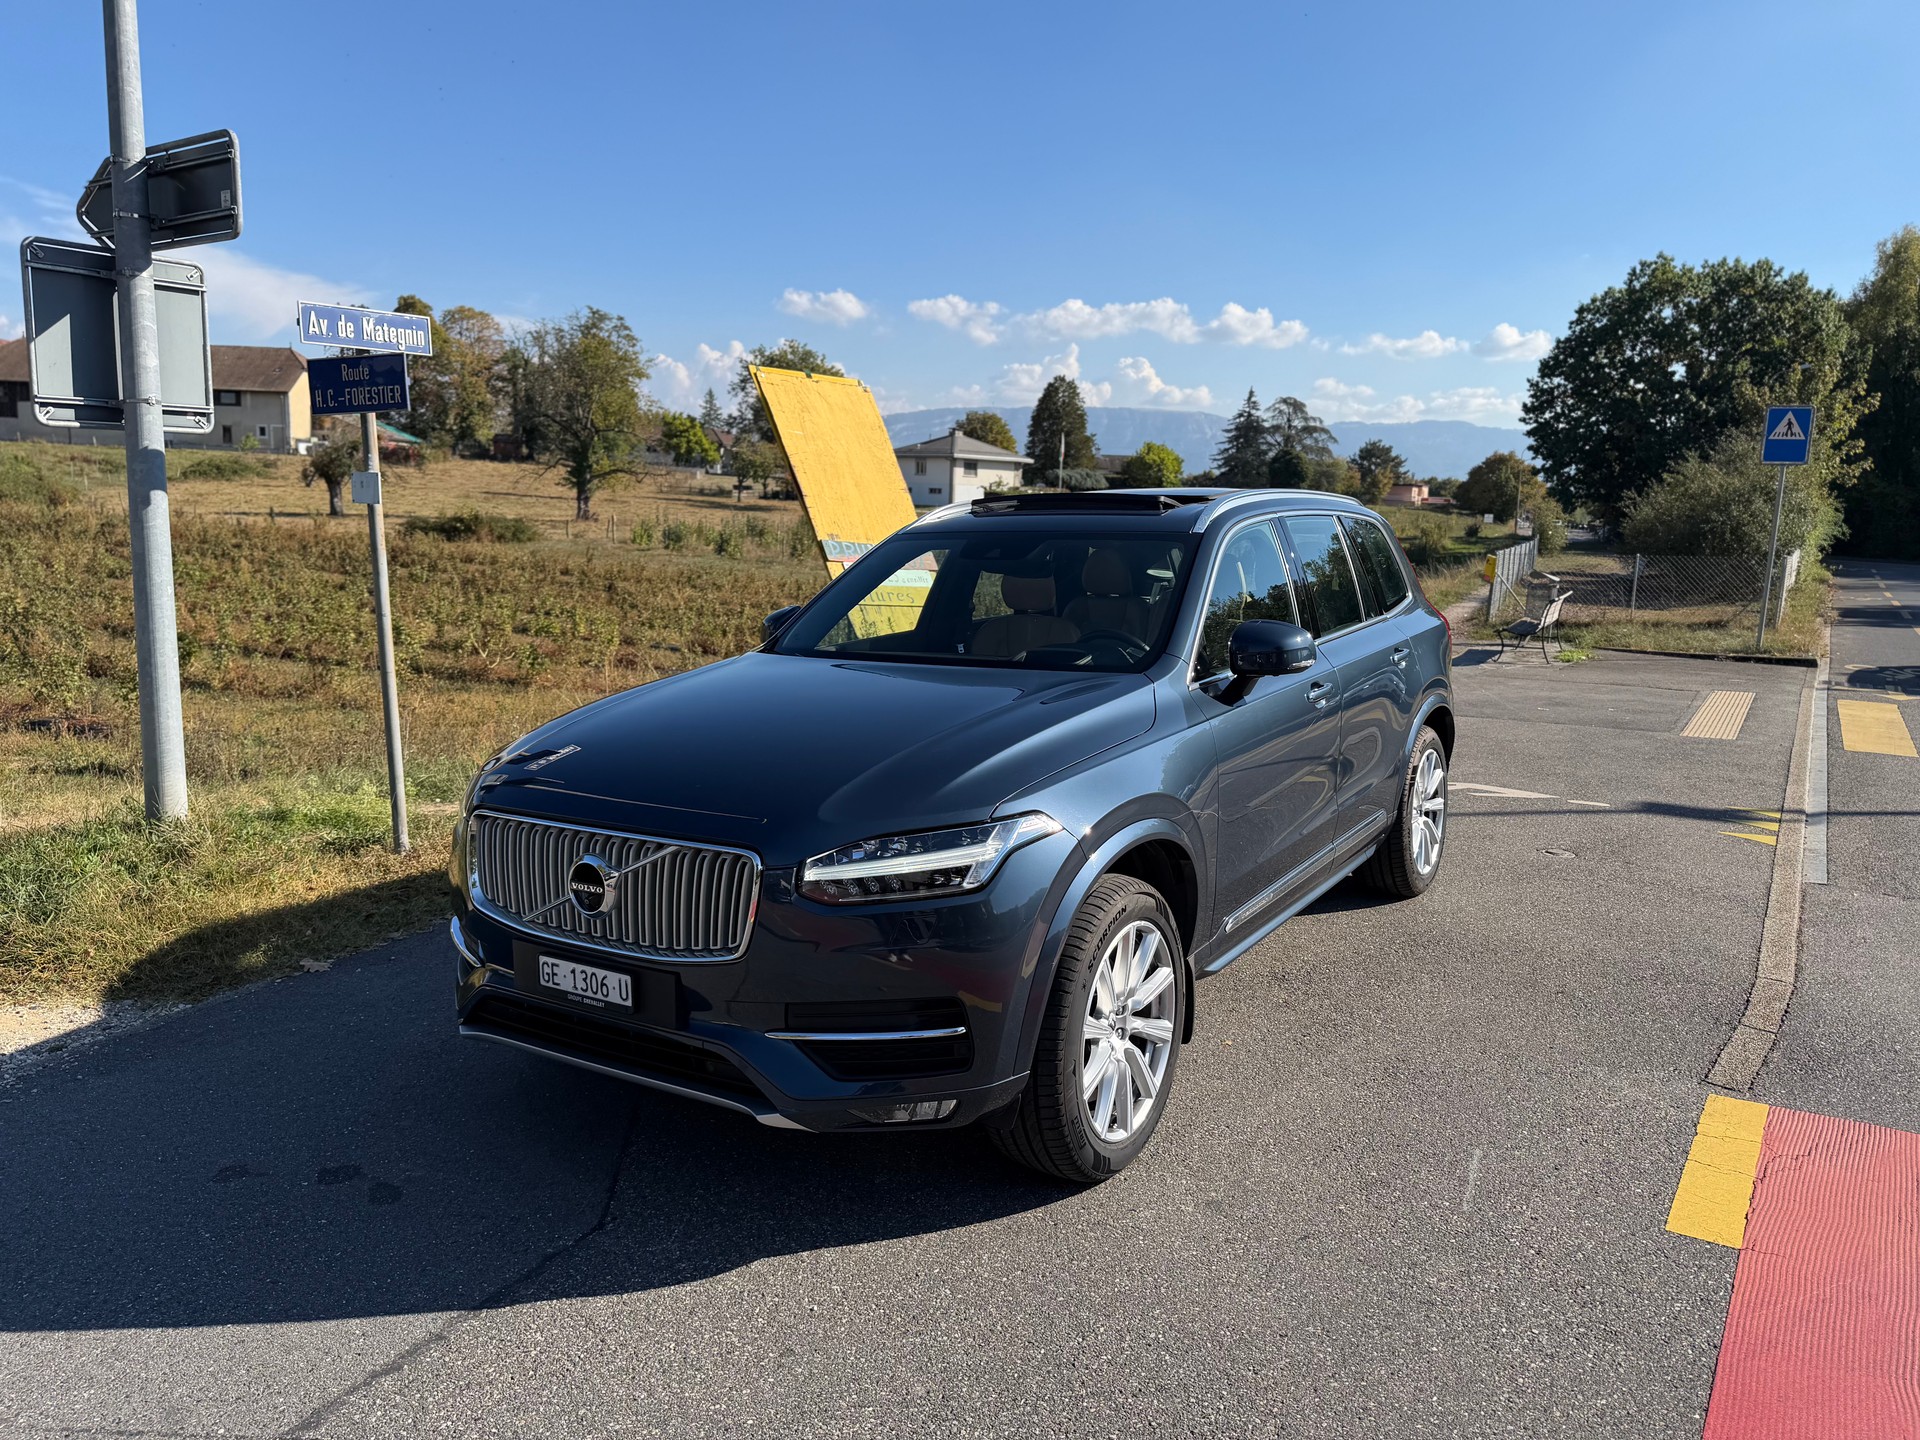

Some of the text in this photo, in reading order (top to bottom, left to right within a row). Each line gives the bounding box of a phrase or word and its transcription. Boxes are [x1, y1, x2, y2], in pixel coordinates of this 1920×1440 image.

[308, 310, 425, 350] Av. de Mategnin
[341, 364, 370, 381] Route
[570, 881, 603, 894] VOLVO
[1087, 904, 1127, 974] SCORPION
